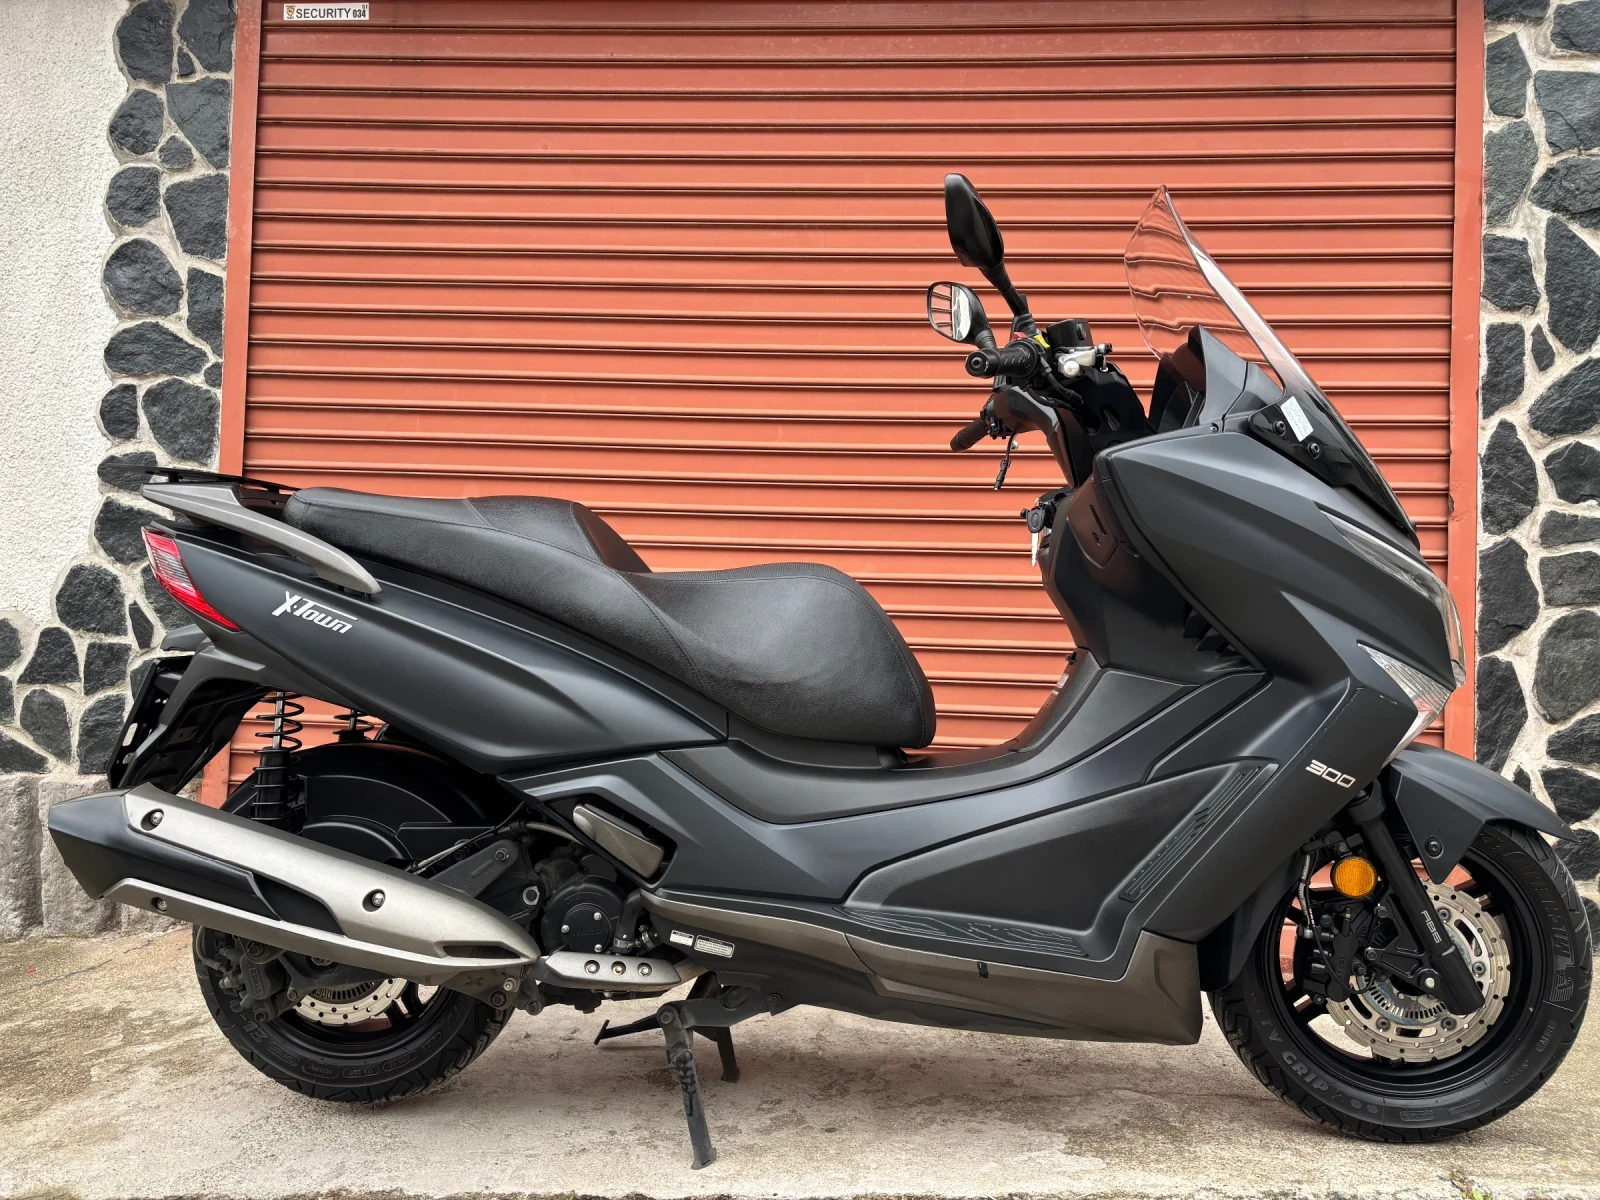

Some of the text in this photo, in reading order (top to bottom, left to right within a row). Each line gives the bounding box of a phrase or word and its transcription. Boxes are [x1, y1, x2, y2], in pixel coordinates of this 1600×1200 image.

[296, 8, 366, 19] SECURITY 034
[1305, 759, 1356, 788] 300
[1420, 909, 1443, 944] ABS
[1281, 1049, 1330, 1092] GRIP
